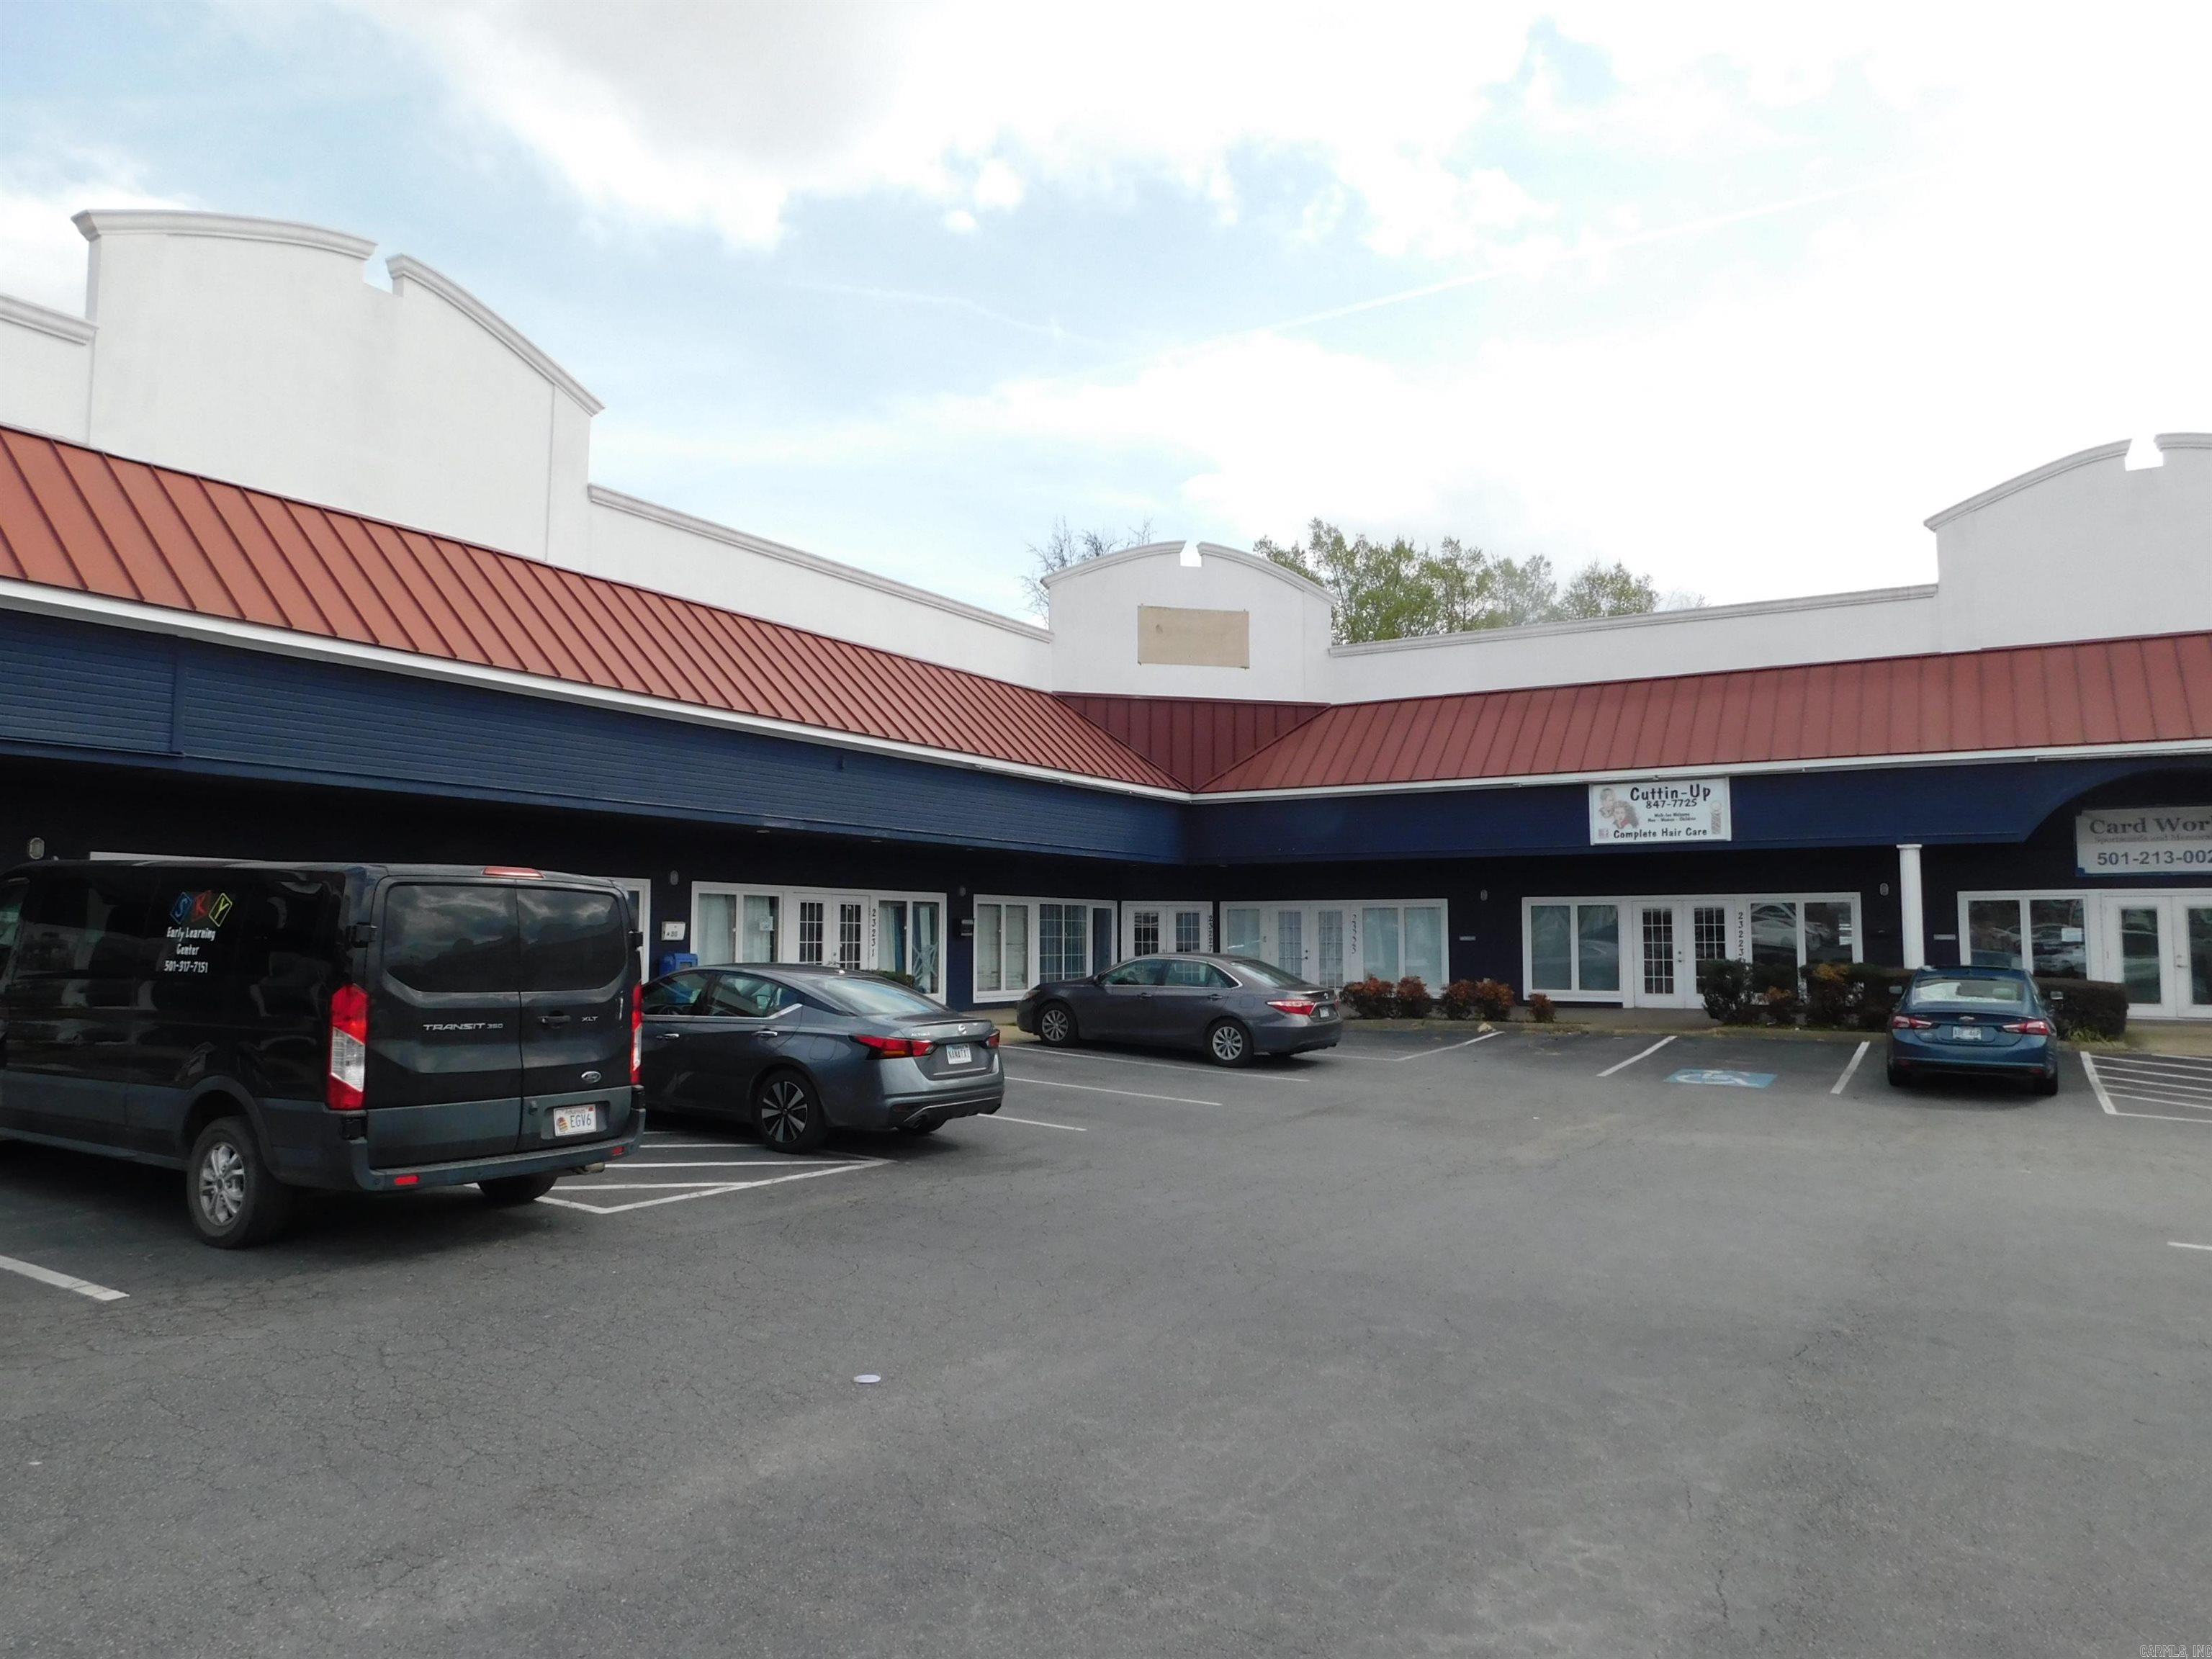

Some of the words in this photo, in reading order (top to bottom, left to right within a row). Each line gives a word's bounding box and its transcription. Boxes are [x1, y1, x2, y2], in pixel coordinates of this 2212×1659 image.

[1630, 783, 1711, 801] Cuttin-Up
[1646, 799, 1697, 809] 847-7725
[2090, 817, 2147, 835] Card
[2153, 815, 2212, 832] Wor
[1614, 830, 1657, 840] Complete
[1661, 828, 1682, 837] Hair
[1686, 827, 1707, 836] Care
[166, 927, 185, 942] Early
[185, 927, 216, 941] Learning
[176, 943, 199, 956] Center
[570, 1114, 591, 1128] EGV6
